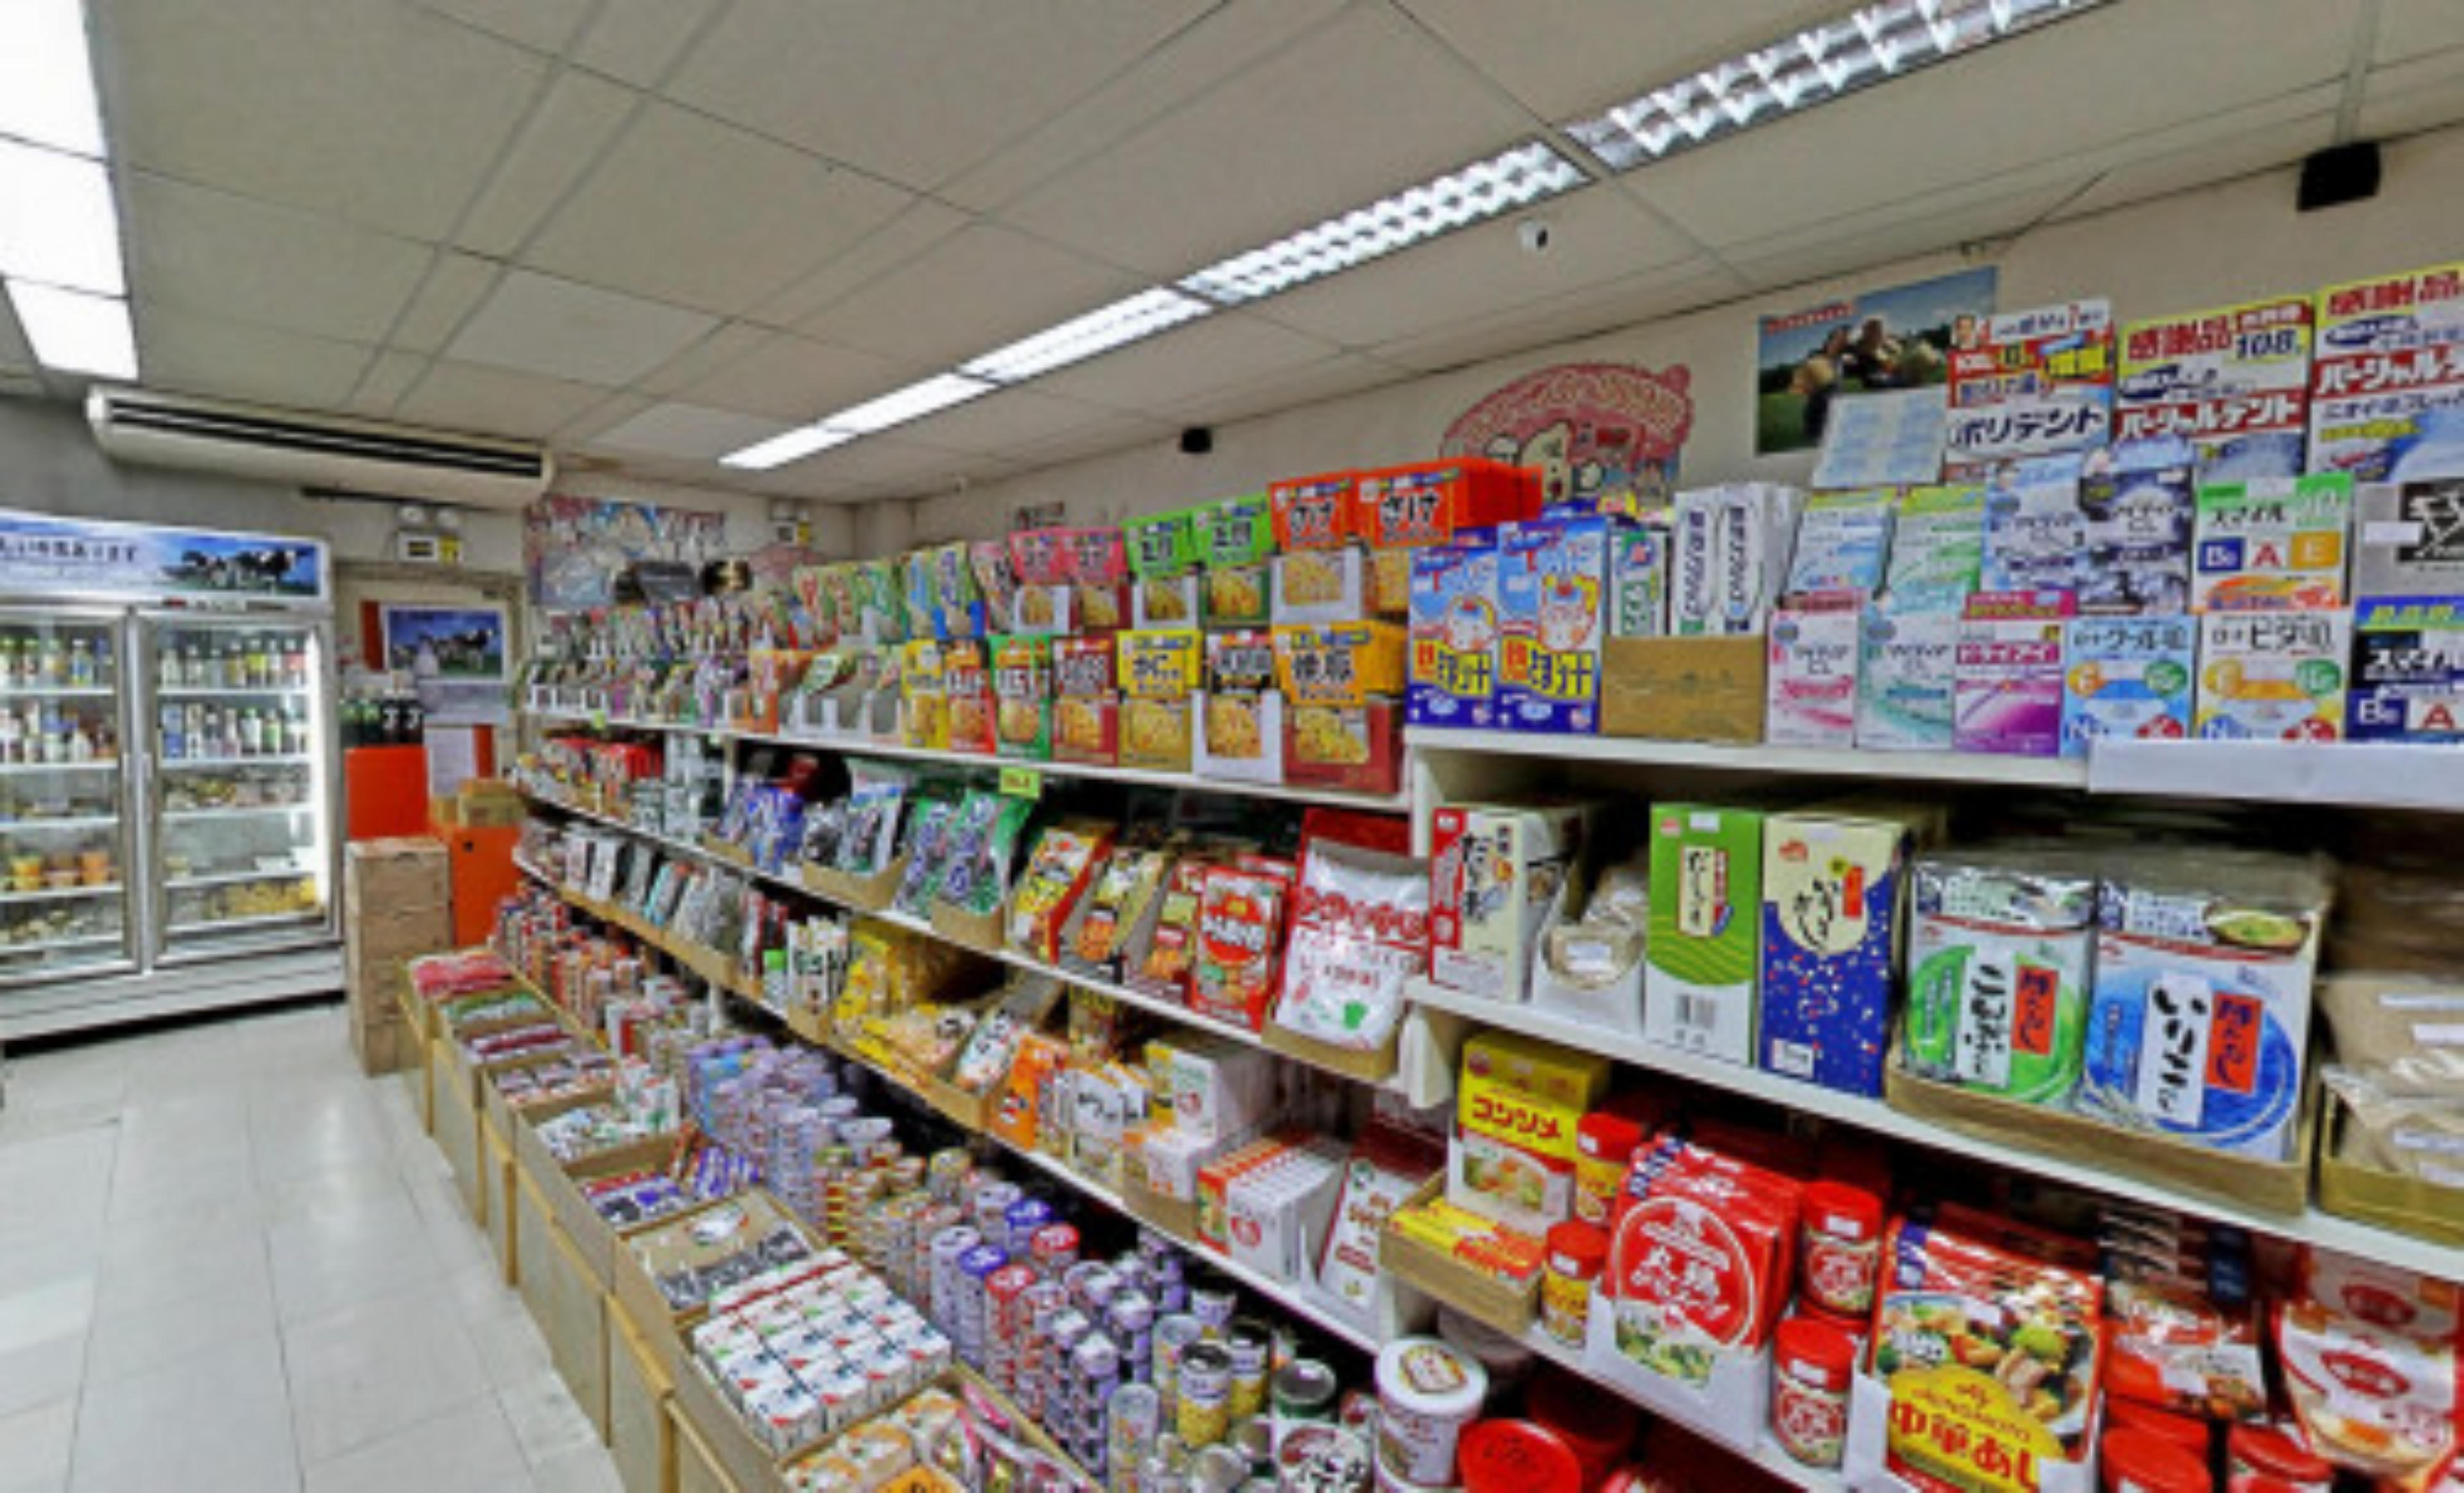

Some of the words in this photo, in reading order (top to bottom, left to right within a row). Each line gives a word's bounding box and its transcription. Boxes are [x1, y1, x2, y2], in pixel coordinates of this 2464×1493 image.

[1954, 405, 2105, 447] ポリデント
[2252, 541, 2281, 568] A
[1471, 1093, 1562, 1141] コンソメ
